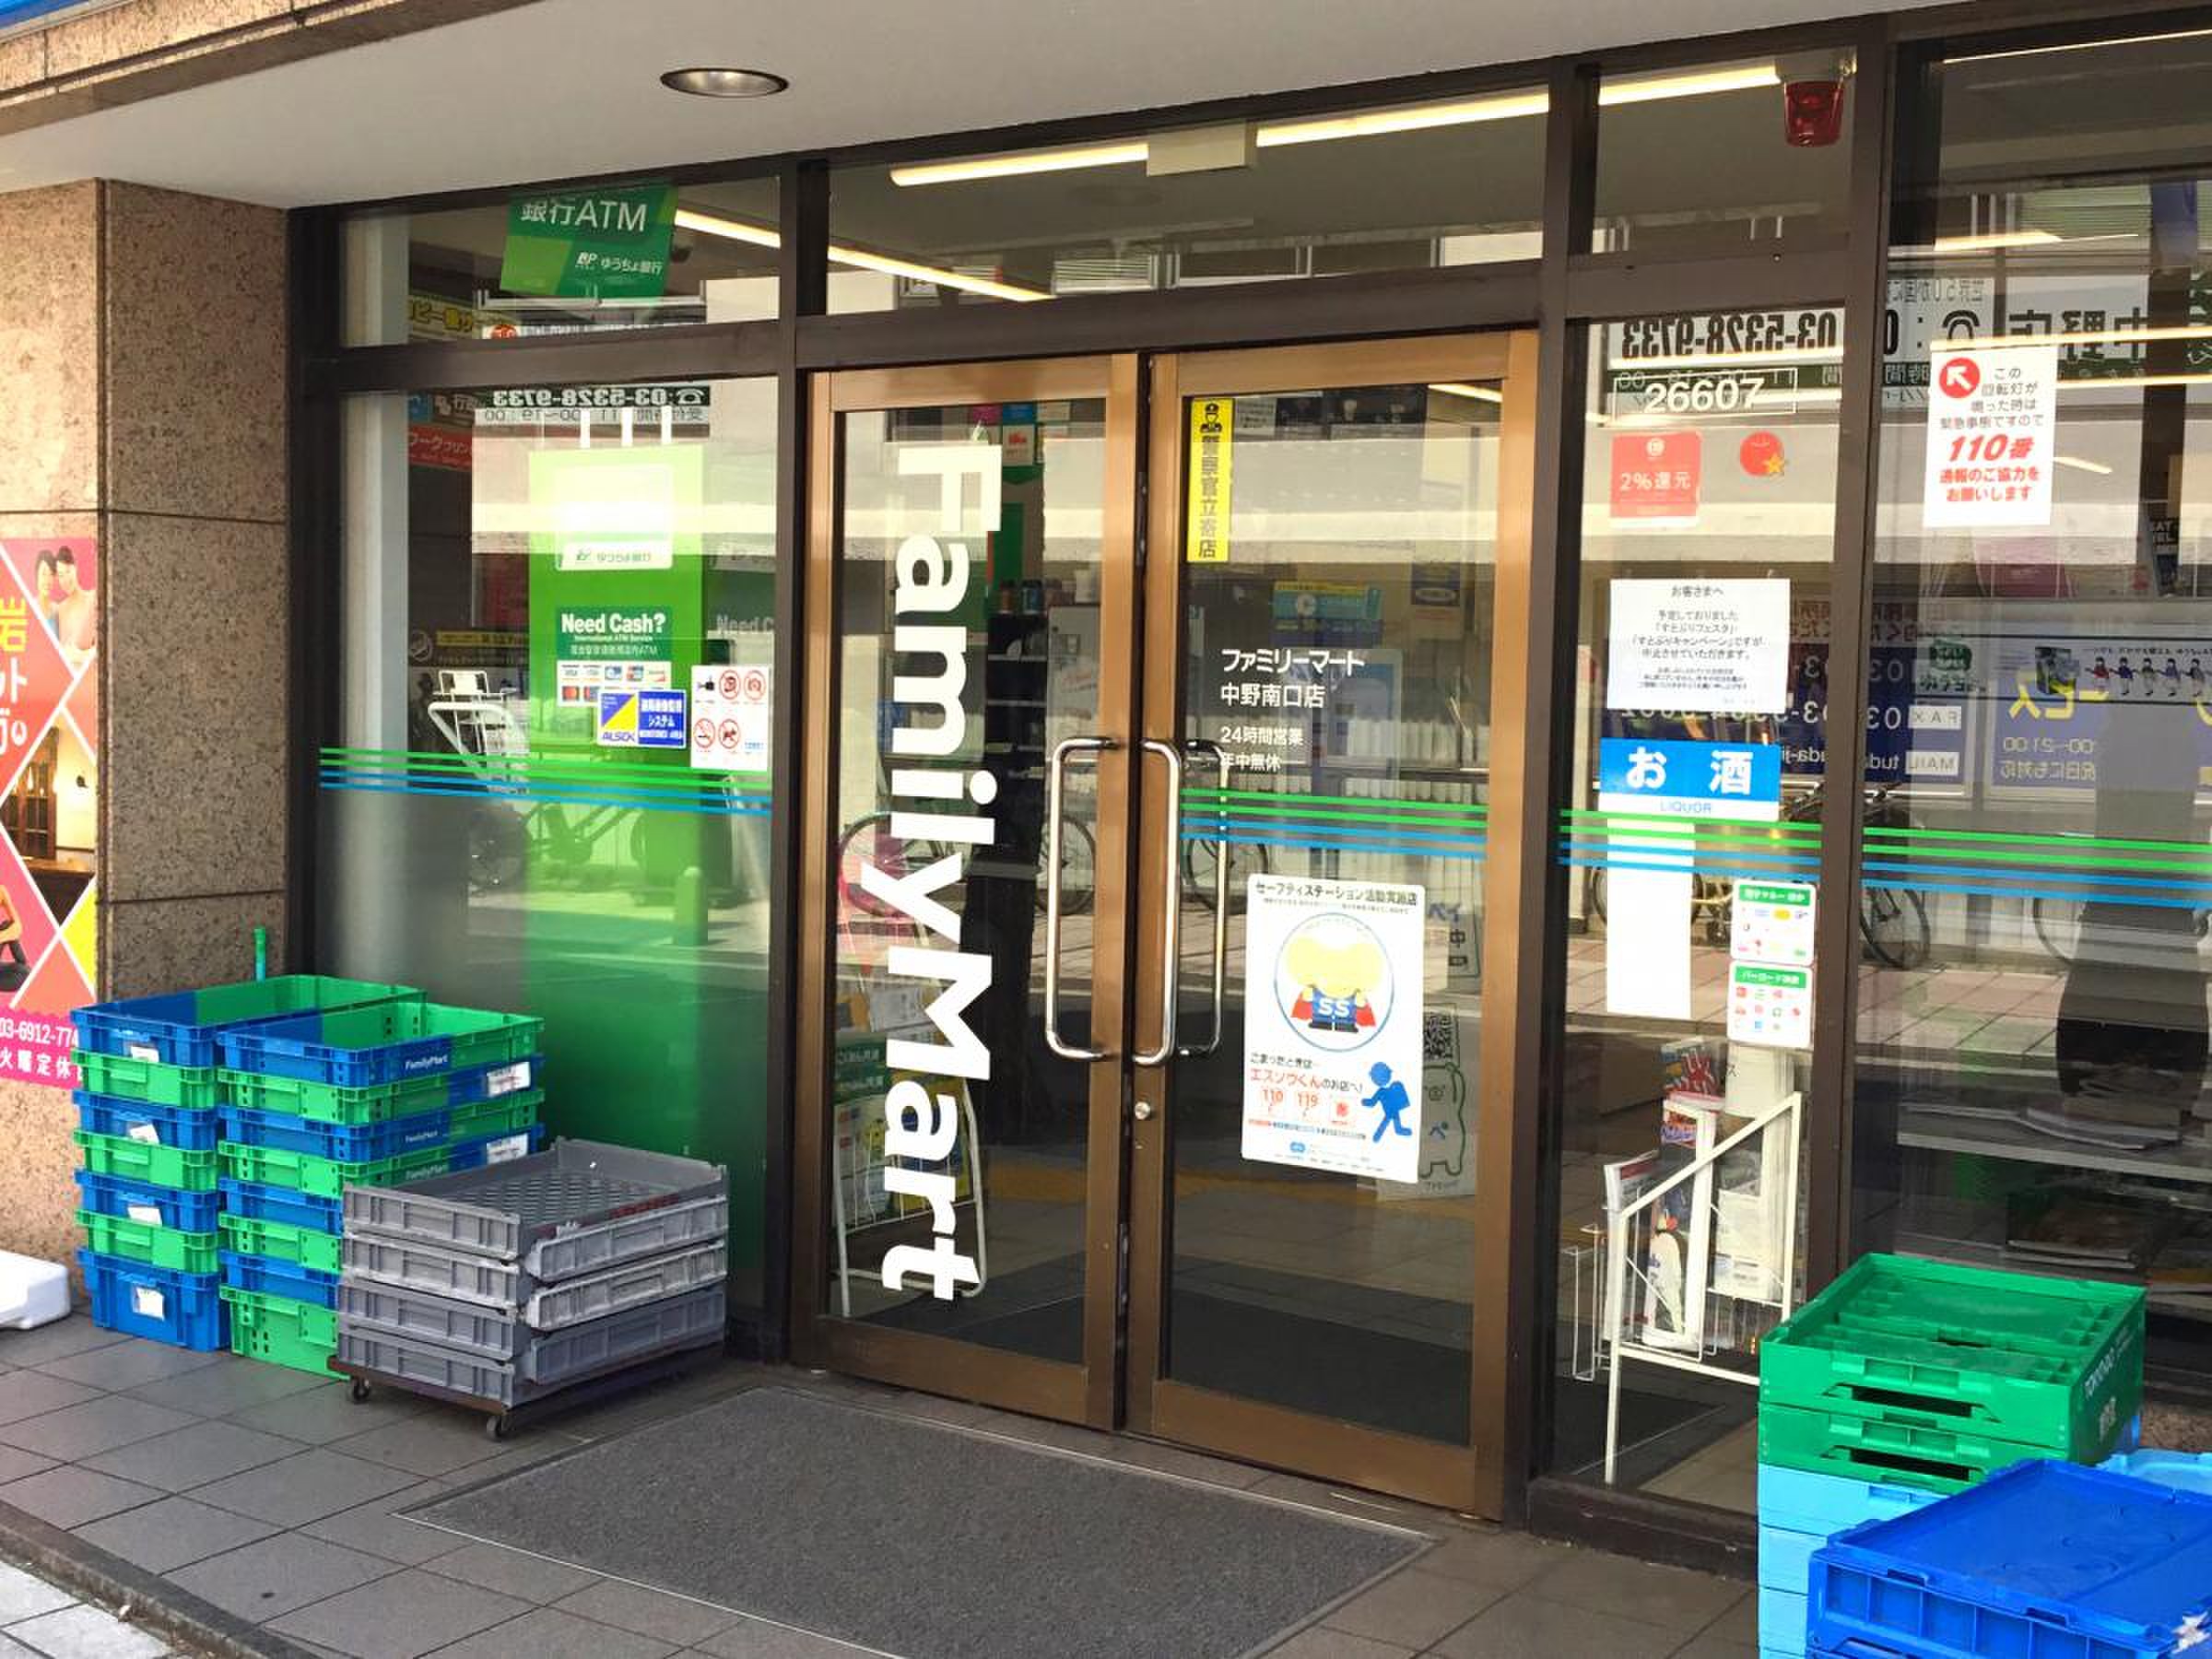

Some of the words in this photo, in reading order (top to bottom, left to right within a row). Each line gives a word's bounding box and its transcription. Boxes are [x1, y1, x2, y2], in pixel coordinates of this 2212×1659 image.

[521, 198, 647, 232] 銀行ATM
[1994, 368, 2021, 380] この
[1644, 377, 1765, 414] 26607
[1948, 433, 2034, 462] 110番
[1940, 465, 2041, 484] 通報のご協力を
[1946, 485, 2033, 502] お願いします
[1671, 585, 1724, 598] お客さまへ
[561, 613, 606, 633] Need
[609, 612, 666, 634] Cash?
[1221, 648, 1366, 677] ファミリーマート
[1220, 681, 1326, 709] 中野南口店
[1220, 724, 1304, 747] 24時間営業
[1660, 800, 1712, 815] LIQUOR
[861, 444, 1002, 1300] FamilyMart
[1318, 998, 1350, 1018] SS
[405, 1054, 449, 1071] FamilyMart
